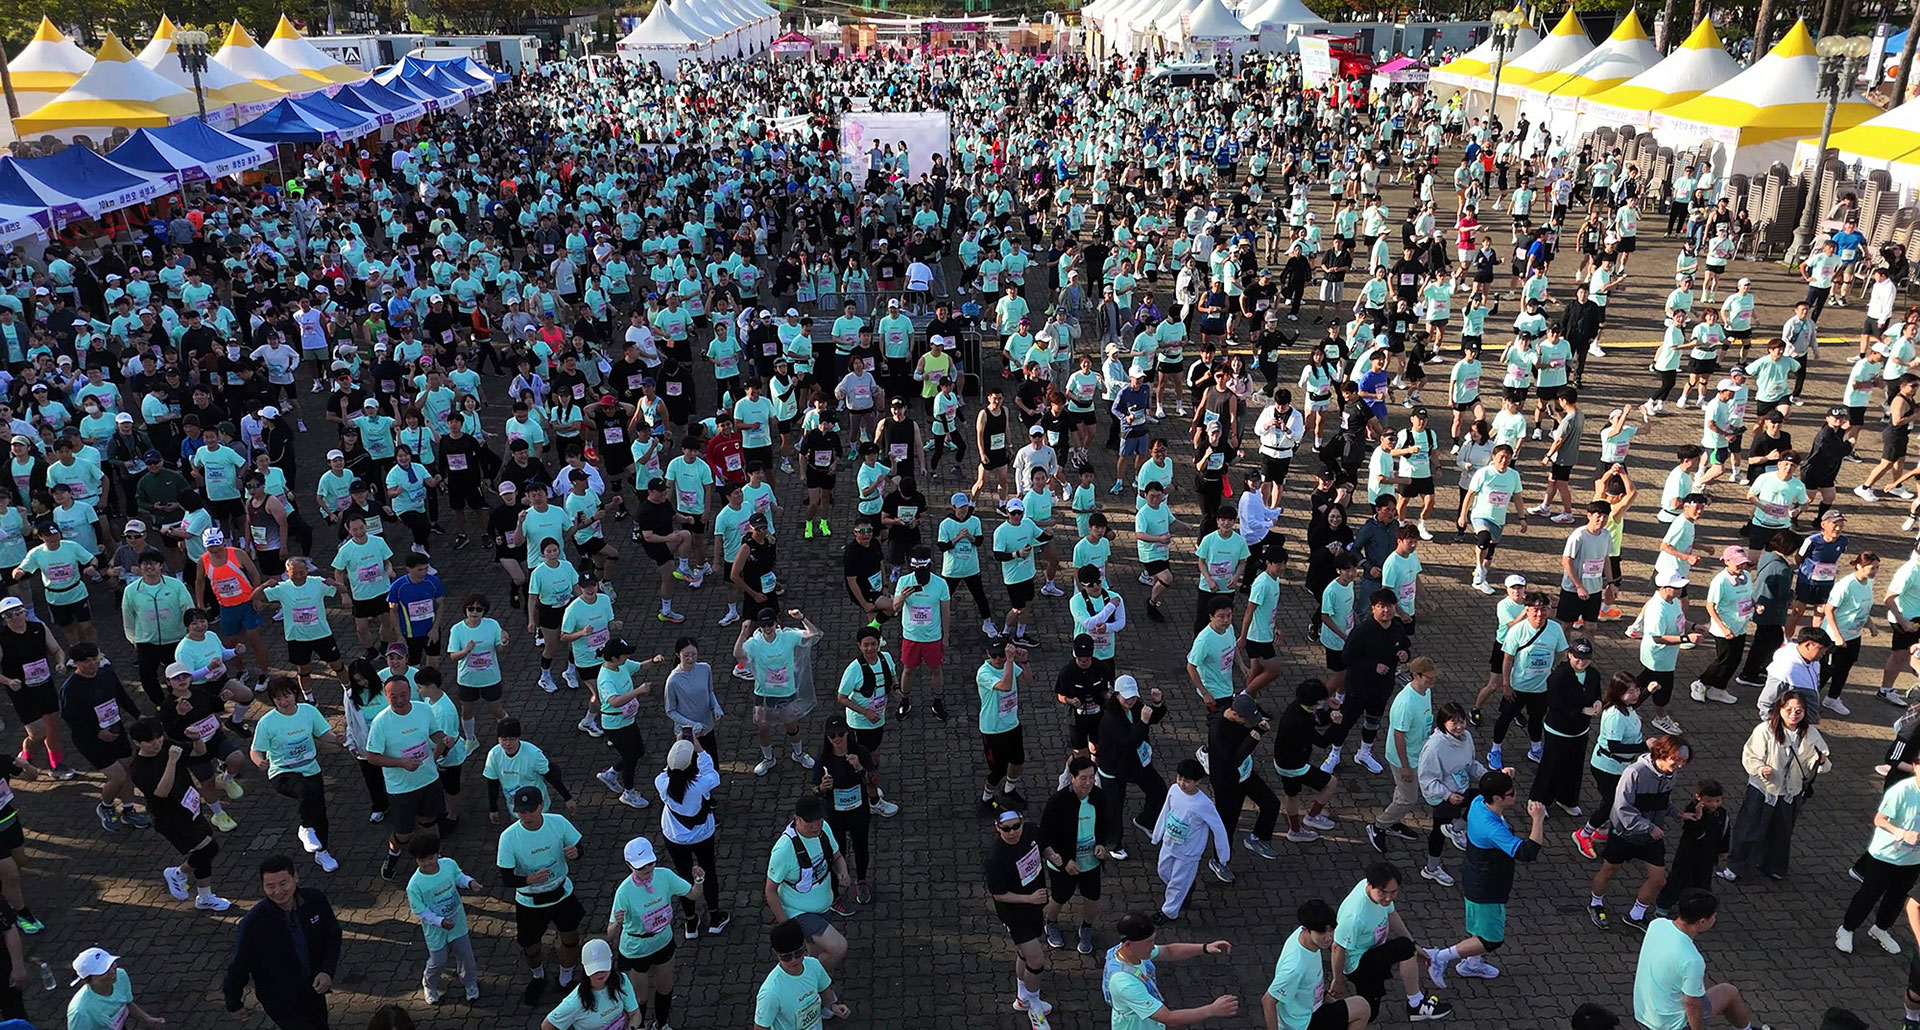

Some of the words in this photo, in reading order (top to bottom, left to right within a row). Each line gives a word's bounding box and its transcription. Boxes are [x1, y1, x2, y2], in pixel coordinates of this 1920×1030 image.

[1877, 25, 1885, 36] E
[216, 163, 229, 173] 10km
[98, 198, 115, 211] 10km
[1419, 1004, 1435, 1015] N
